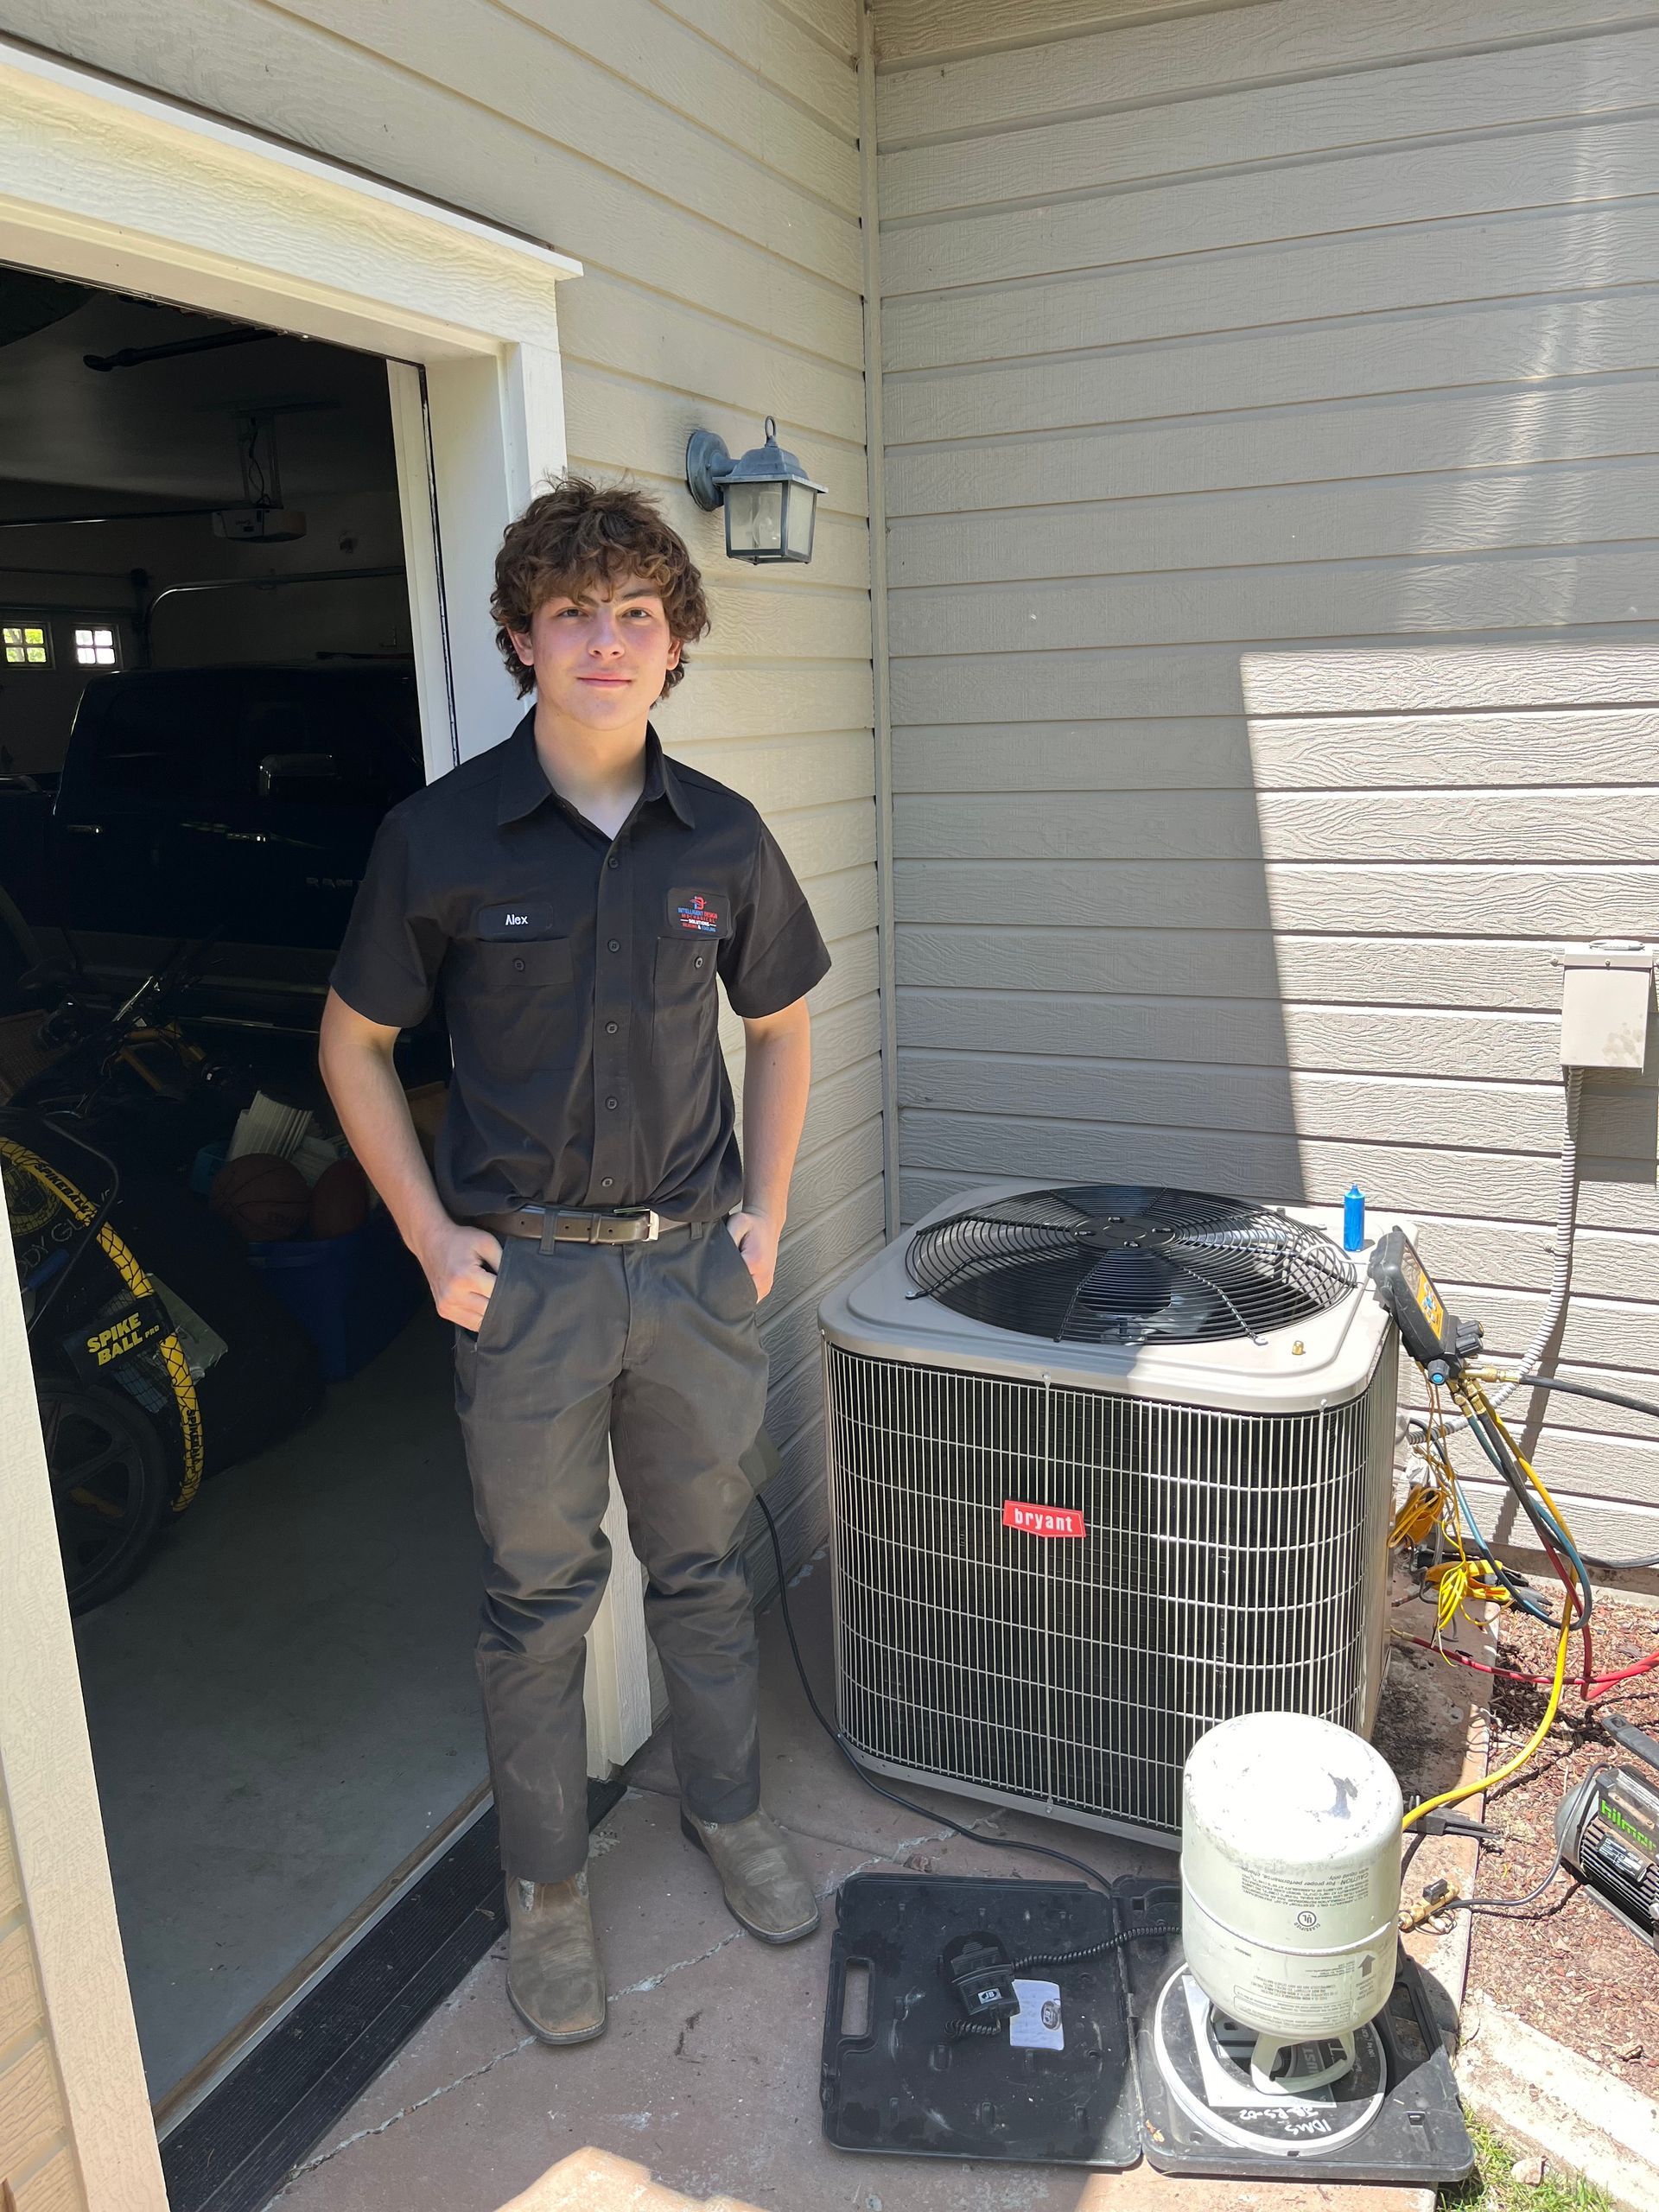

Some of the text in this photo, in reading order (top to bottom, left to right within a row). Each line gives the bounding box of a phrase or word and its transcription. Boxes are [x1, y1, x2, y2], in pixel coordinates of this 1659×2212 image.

[505, 913, 529, 925] Alex
[87, 1312, 142, 1353] SPIKE
[144, 1325, 160, 1338] PRO
[98, 1331, 143, 1366] BALL
[1014, 1507, 1072, 1532] bryant
[1340, 1872, 1369, 1885] CAUTION
[985, 1991, 995, 1999] JB
